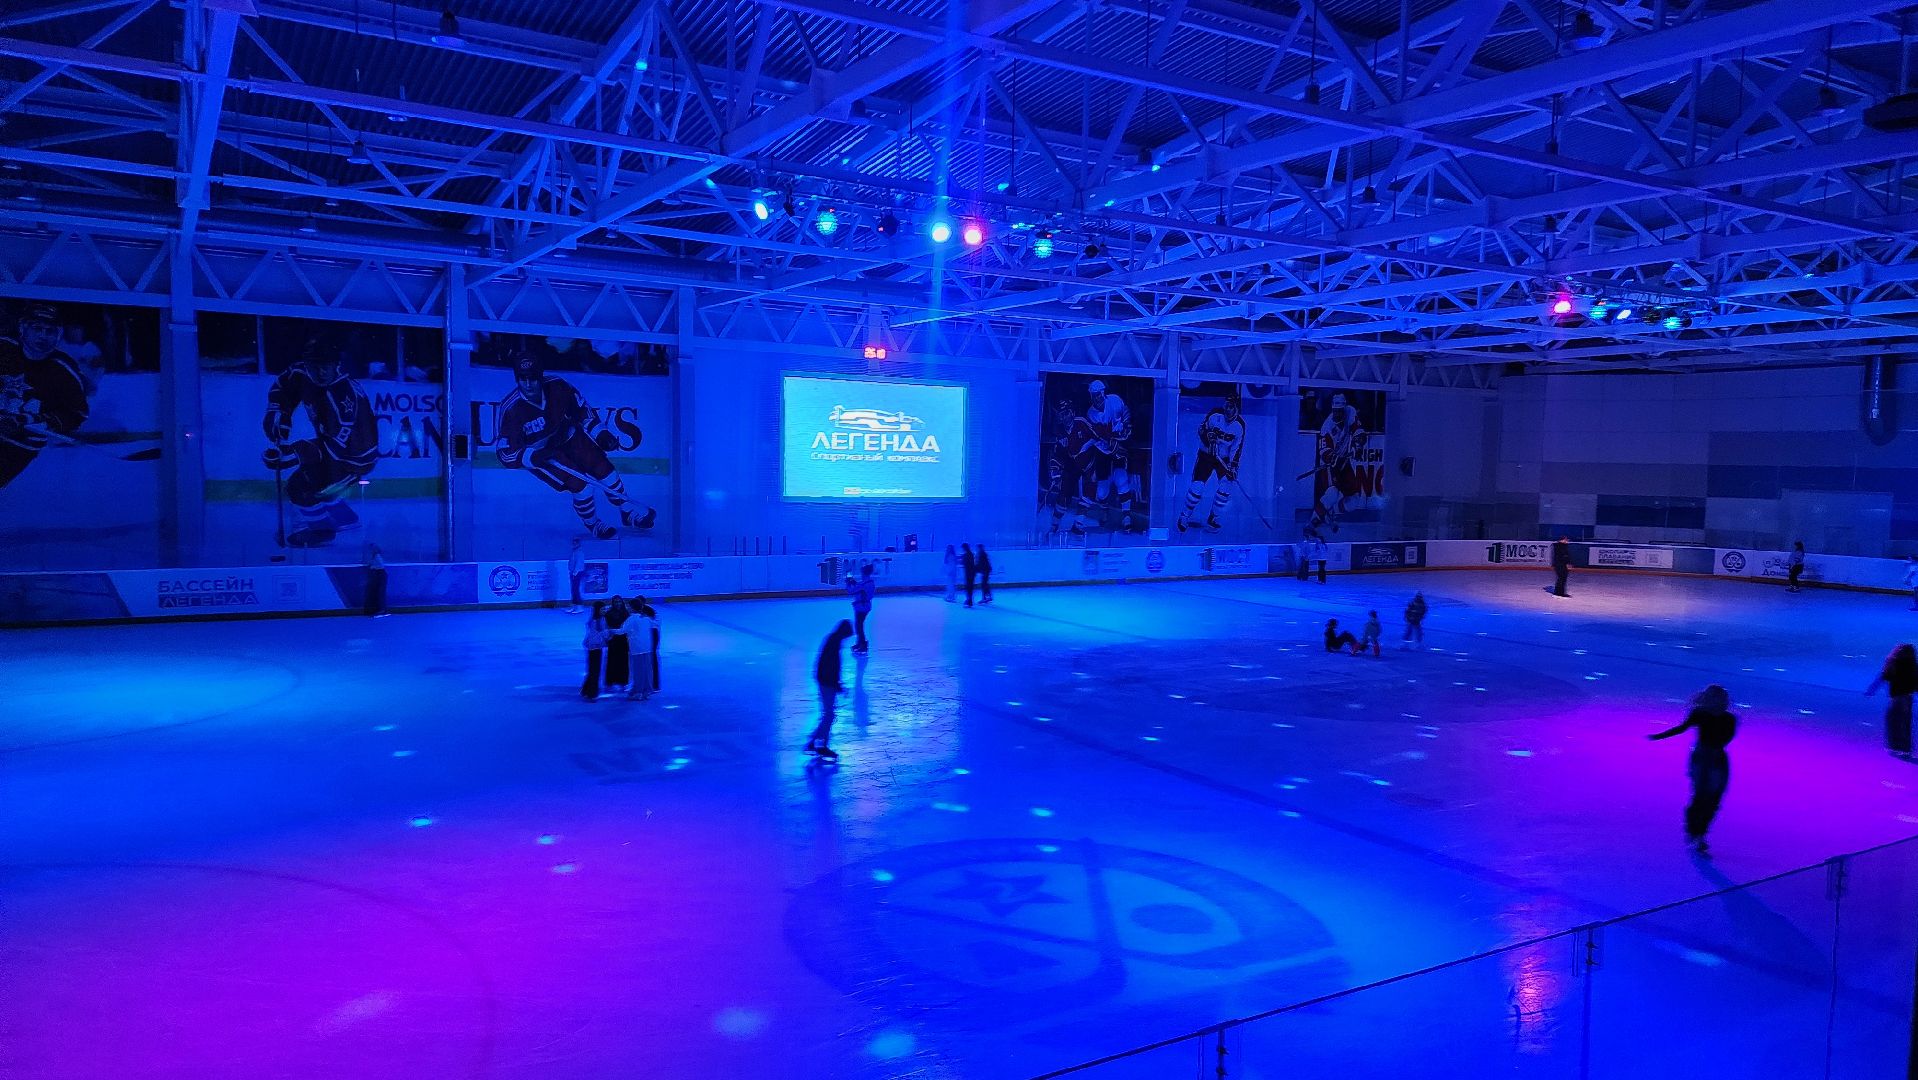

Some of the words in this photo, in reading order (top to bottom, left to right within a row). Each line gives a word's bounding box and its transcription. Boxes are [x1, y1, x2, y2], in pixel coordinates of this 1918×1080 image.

[811, 432, 940, 452] ЛЕГЕНДА
[1506, 544, 1548, 558] МОСТ
[158, 576, 254, 592] БАССЕЙН
[161, 594, 260, 607] ЛЕГЕНДА
